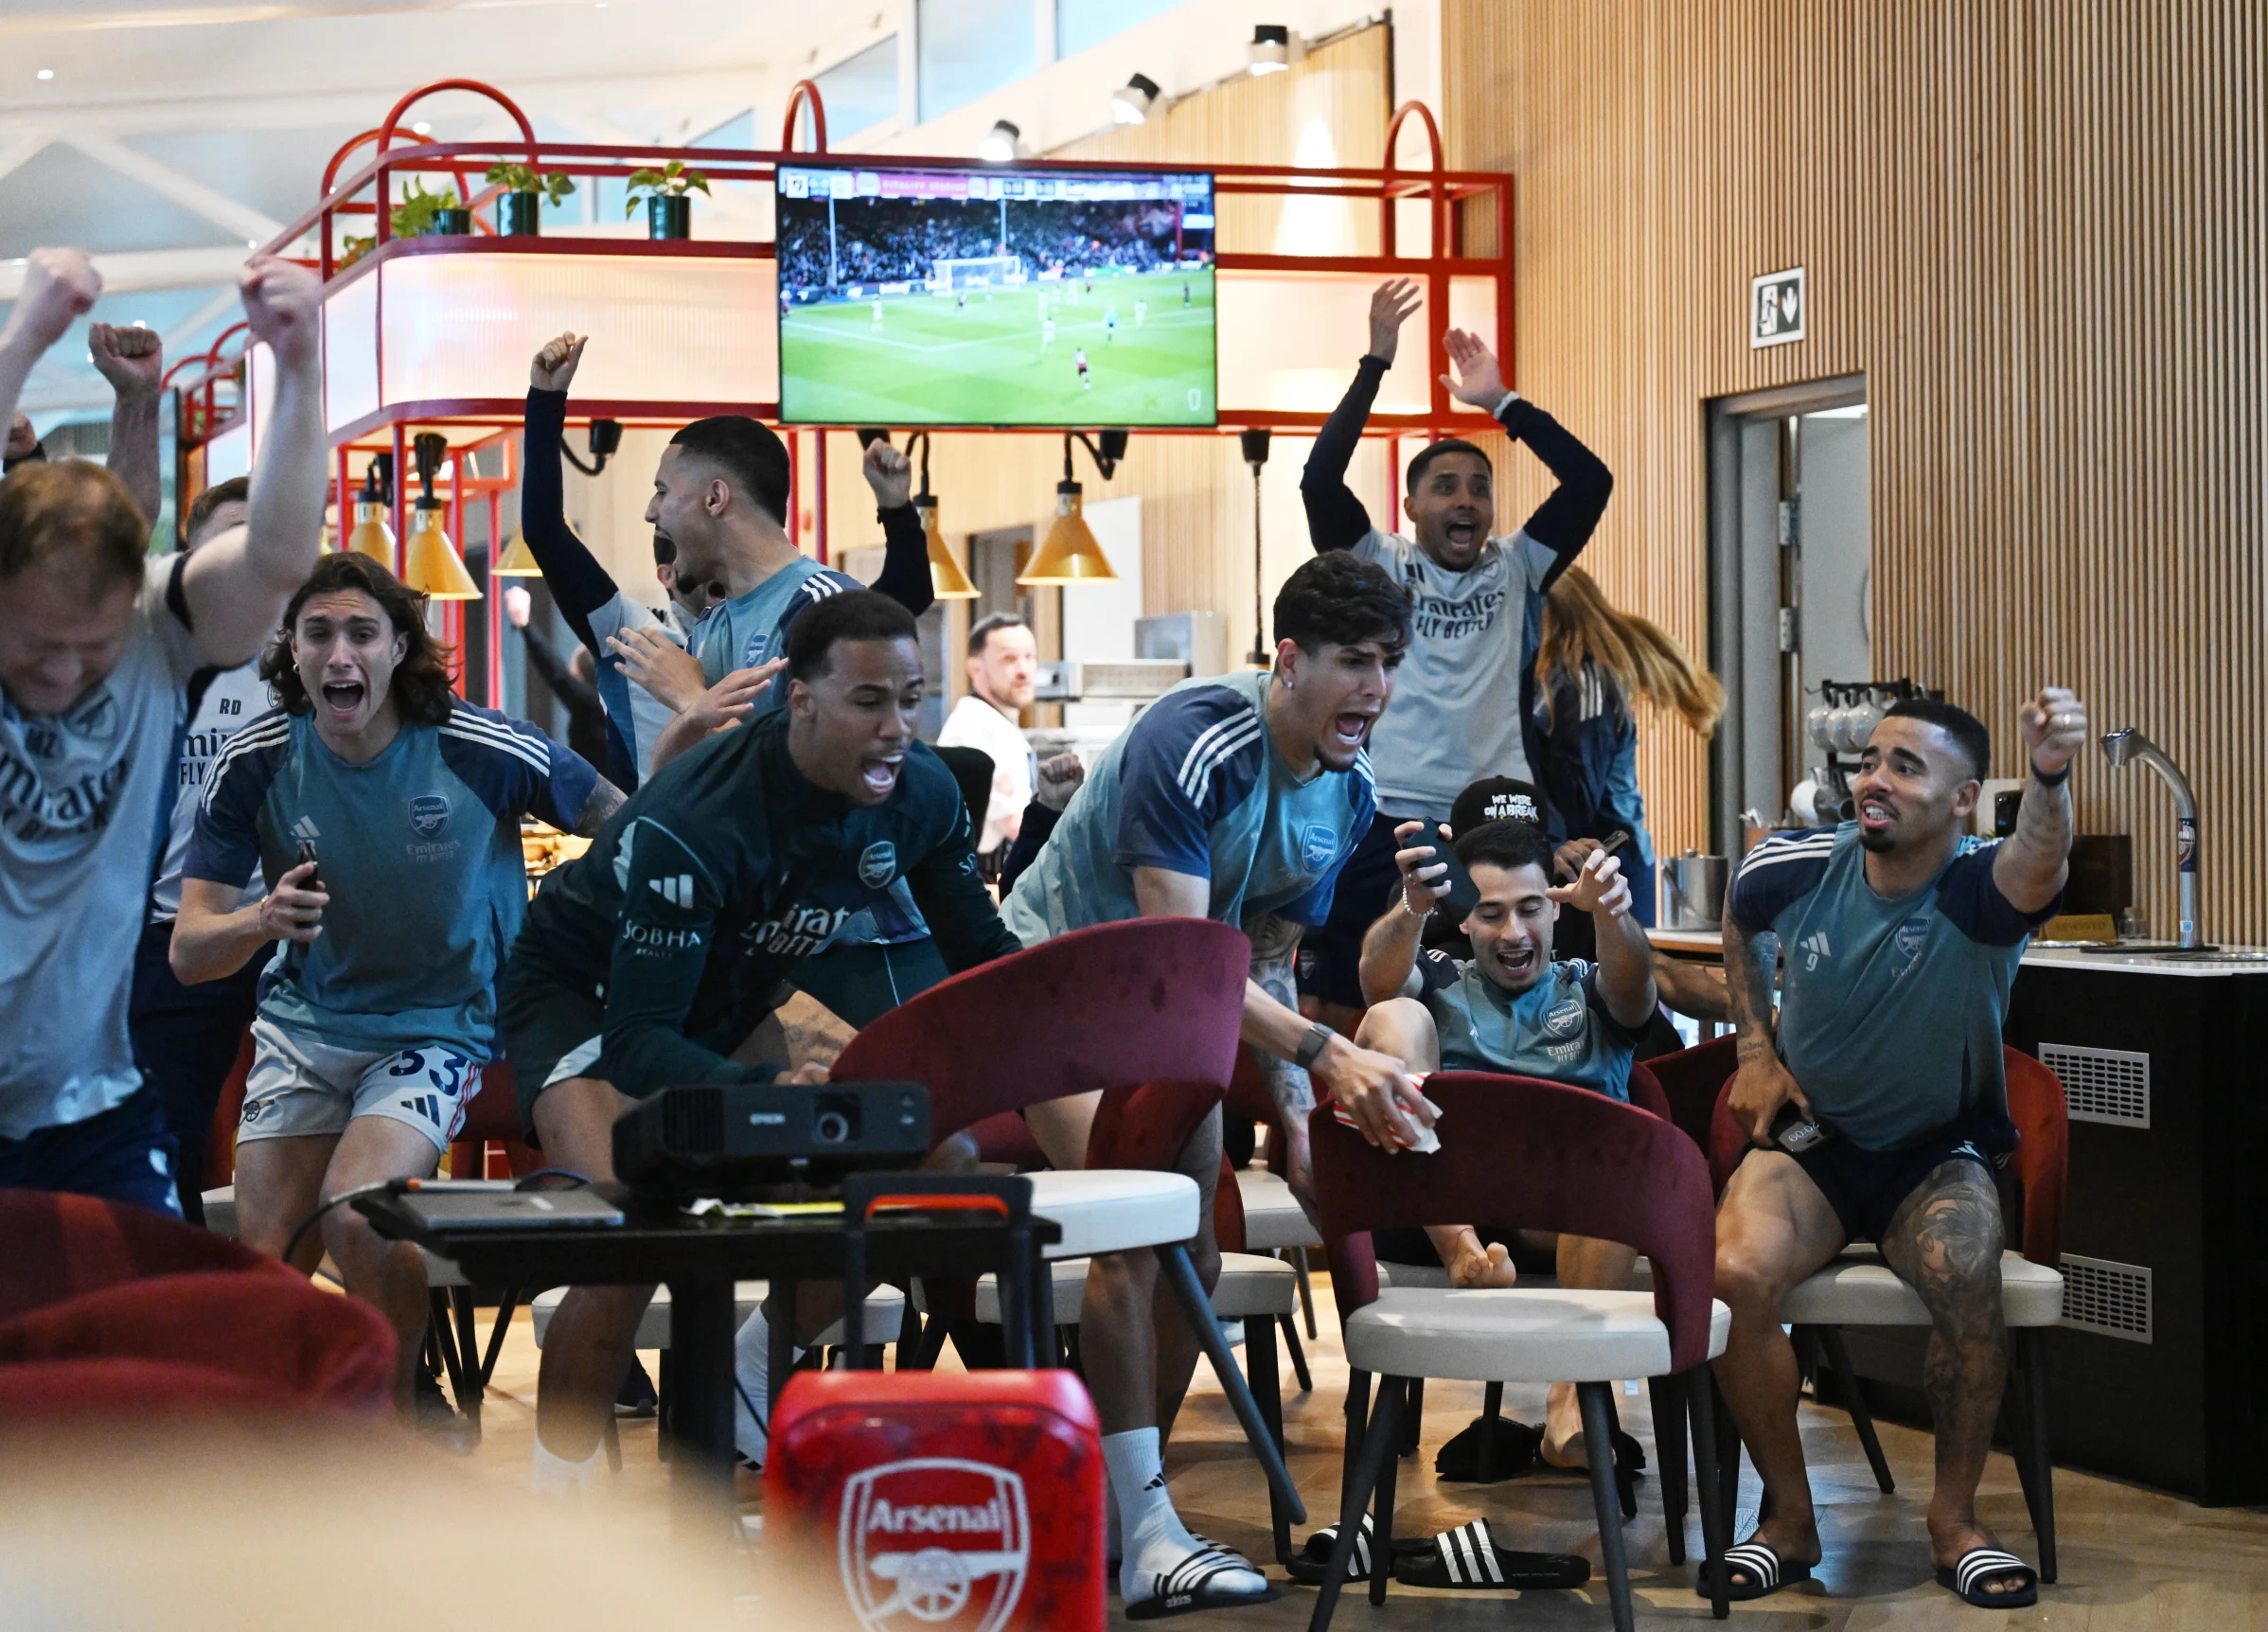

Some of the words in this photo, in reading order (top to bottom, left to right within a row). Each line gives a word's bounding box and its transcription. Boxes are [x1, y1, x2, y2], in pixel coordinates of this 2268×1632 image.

[1416, 615, 1441, 638] FLY
[219, 698, 241, 716] RD
[180, 761, 205, 785] FLY
[1491, 794, 1507, 805] WE
[1508, 793, 1533, 807] WERE
[1483, 804, 1497, 819] ON
[1498, 805, 1506, 817] A
[1506, 804, 1538, 821] BREAK
[623, 919, 701, 949] SOBHA
[1805, 952, 1819, 972] 9
[1549, 1004, 1575, 1019] Arsenal
[1547, 1041, 1586, 1057] Emira
[867, 1498, 1001, 1533] Arsenal
